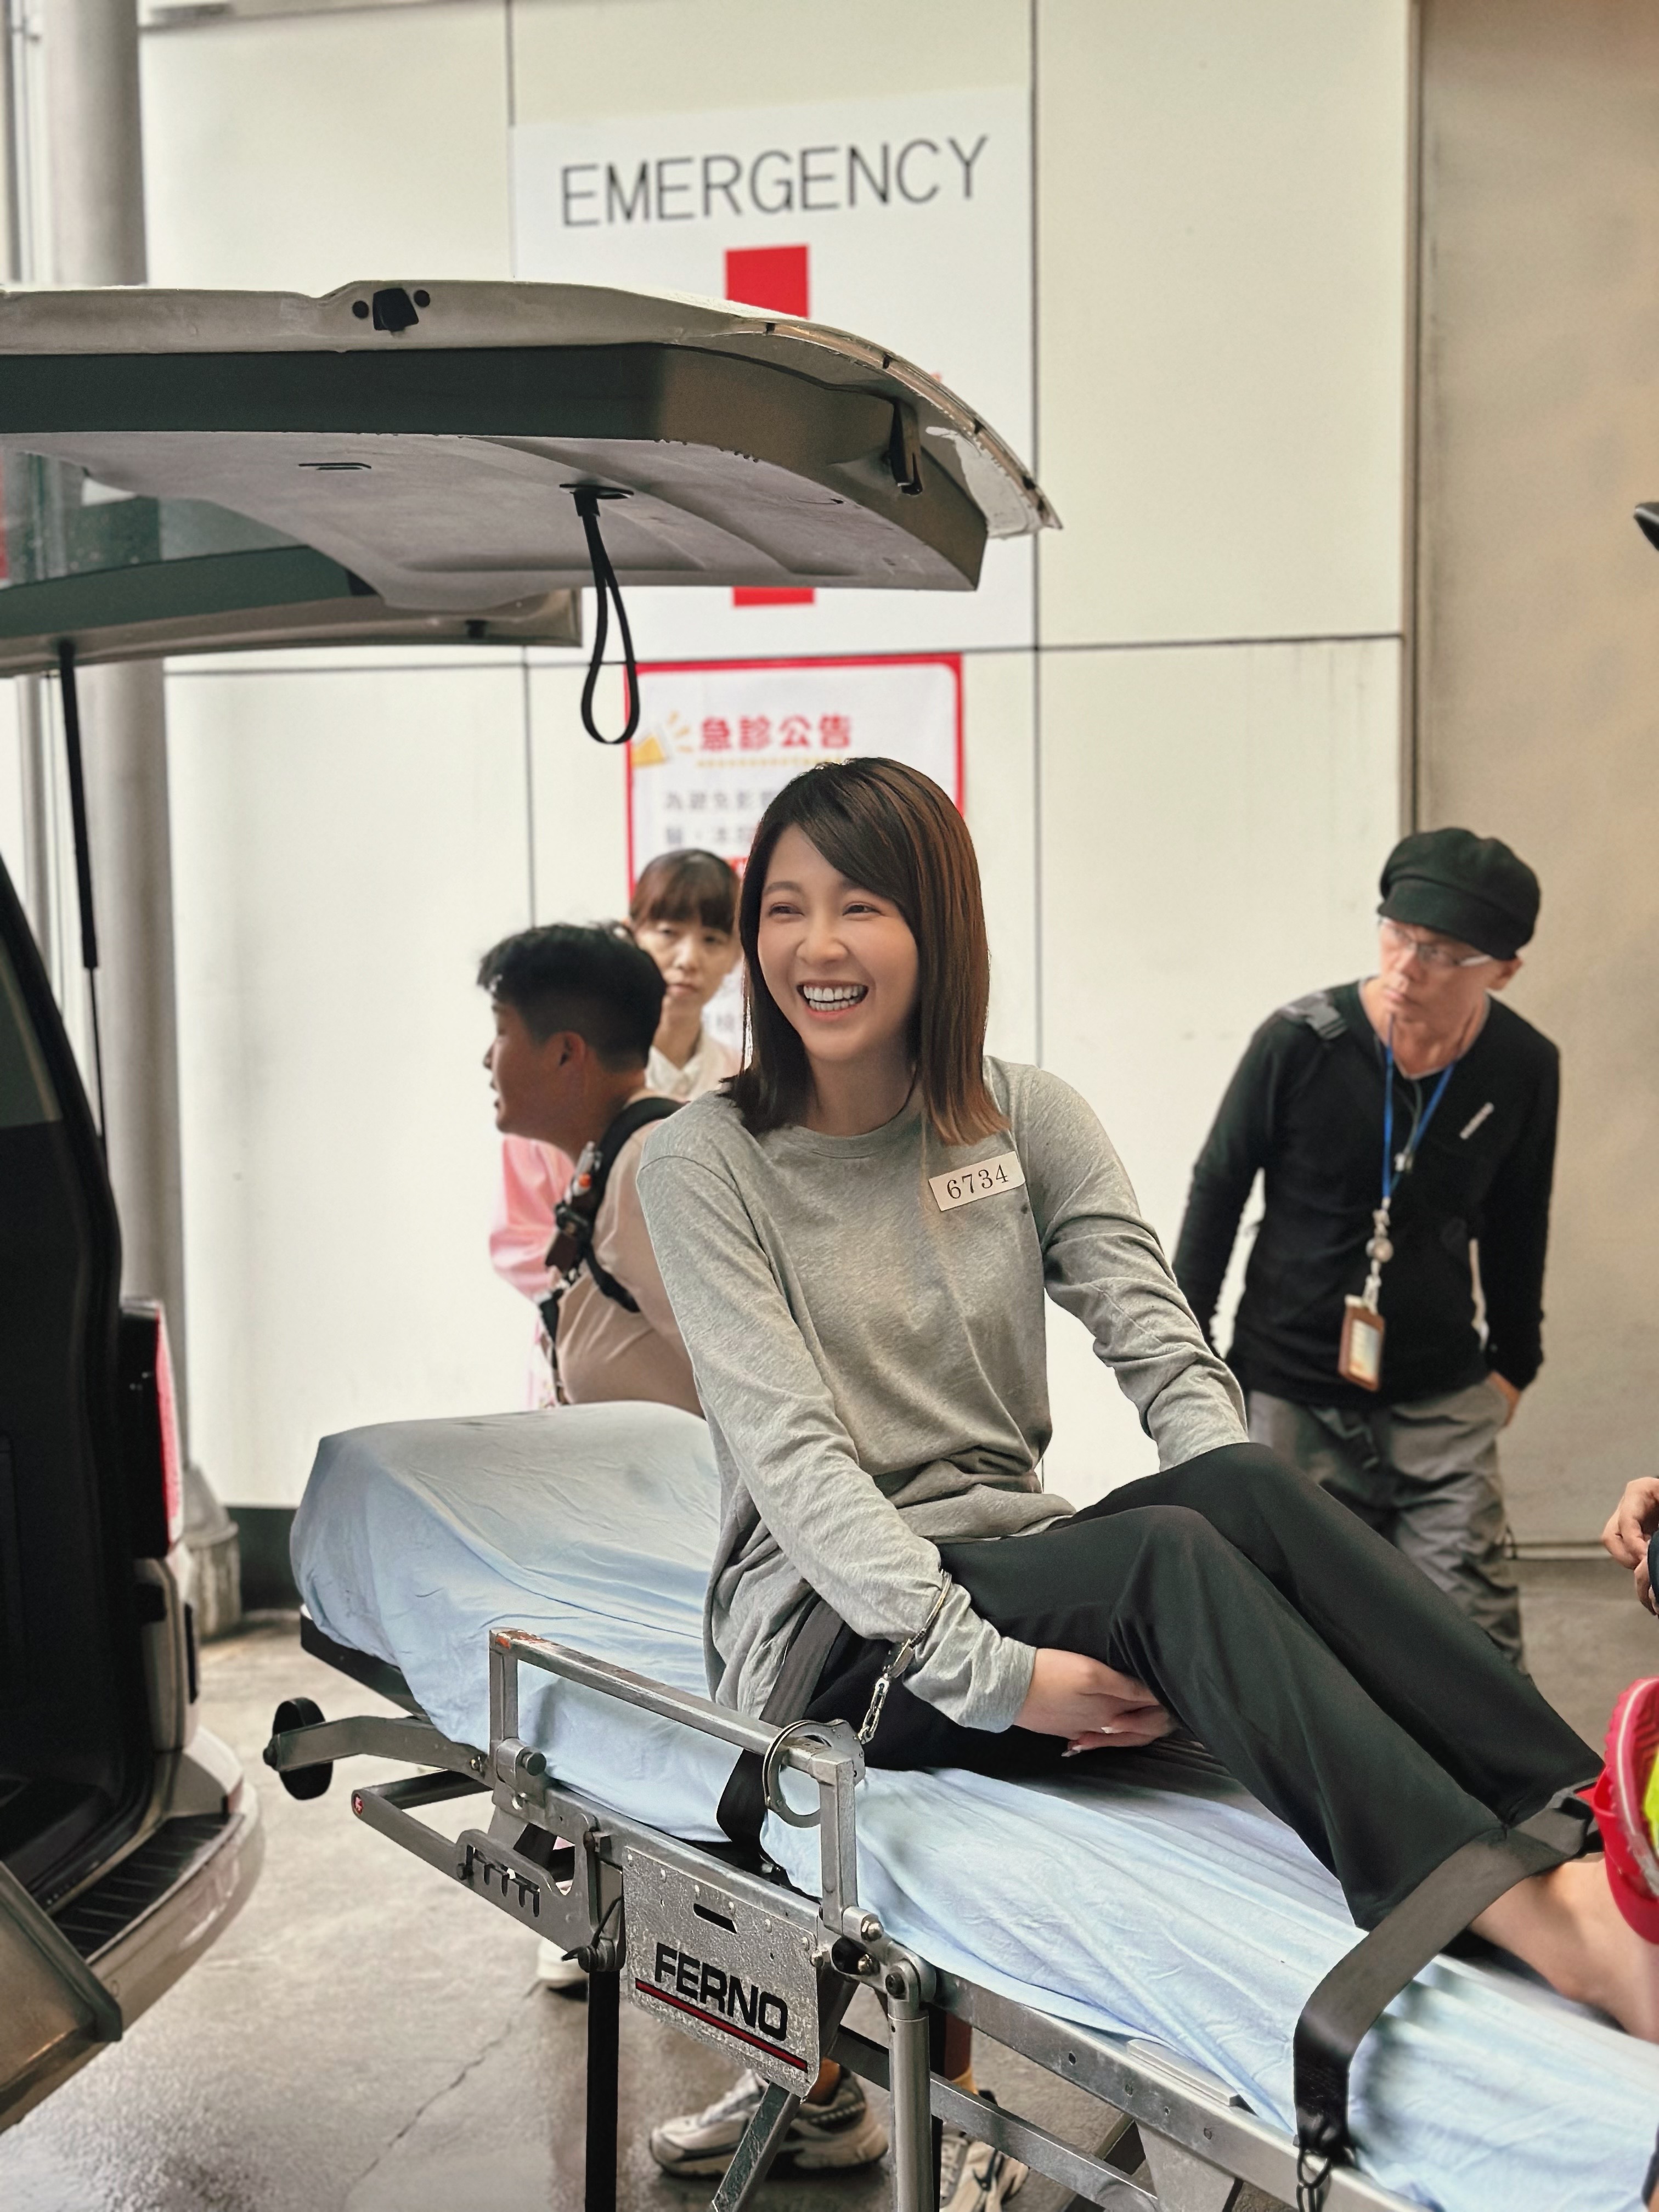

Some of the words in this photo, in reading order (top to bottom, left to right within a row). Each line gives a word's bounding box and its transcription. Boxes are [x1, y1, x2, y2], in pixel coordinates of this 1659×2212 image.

[561, 136, 988, 227] EMERGENCY
[702, 714, 850, 752] 急診公告
[946, 1164, 1009, 1199] 6734
[654, 1942, 788, 2041] FERNO
